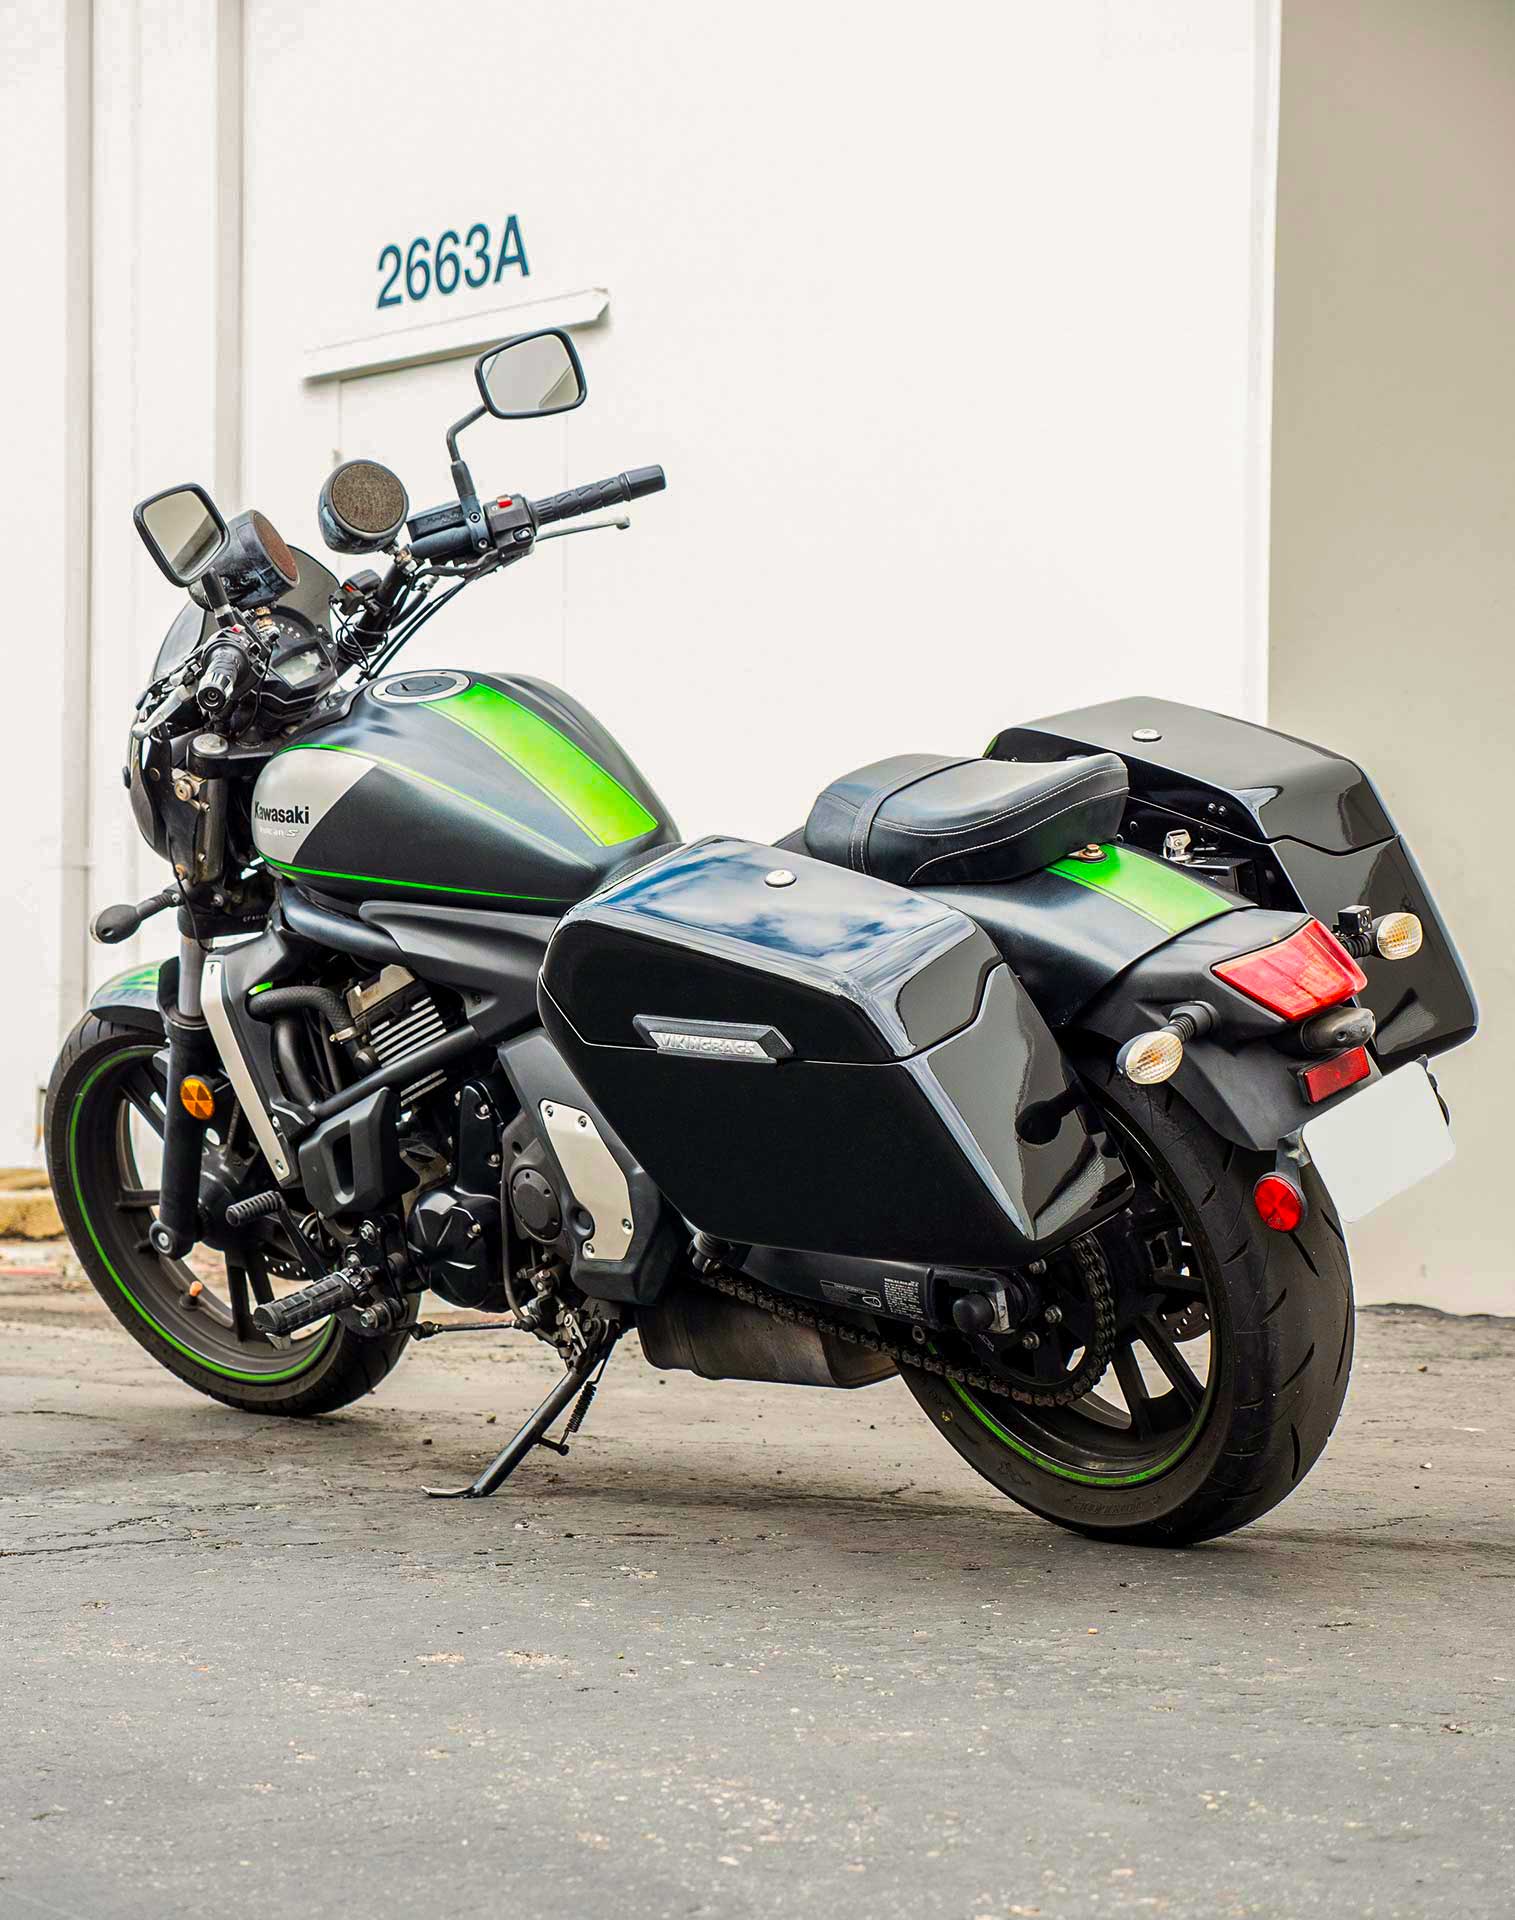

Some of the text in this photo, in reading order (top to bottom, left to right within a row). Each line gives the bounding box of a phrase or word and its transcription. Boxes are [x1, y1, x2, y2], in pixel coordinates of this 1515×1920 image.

[376, 214, 530, 309] 2663A
[254, 800, 310, 825] Kawasaki
[659, 1034, 756, 1055] VIKINGBAGS
